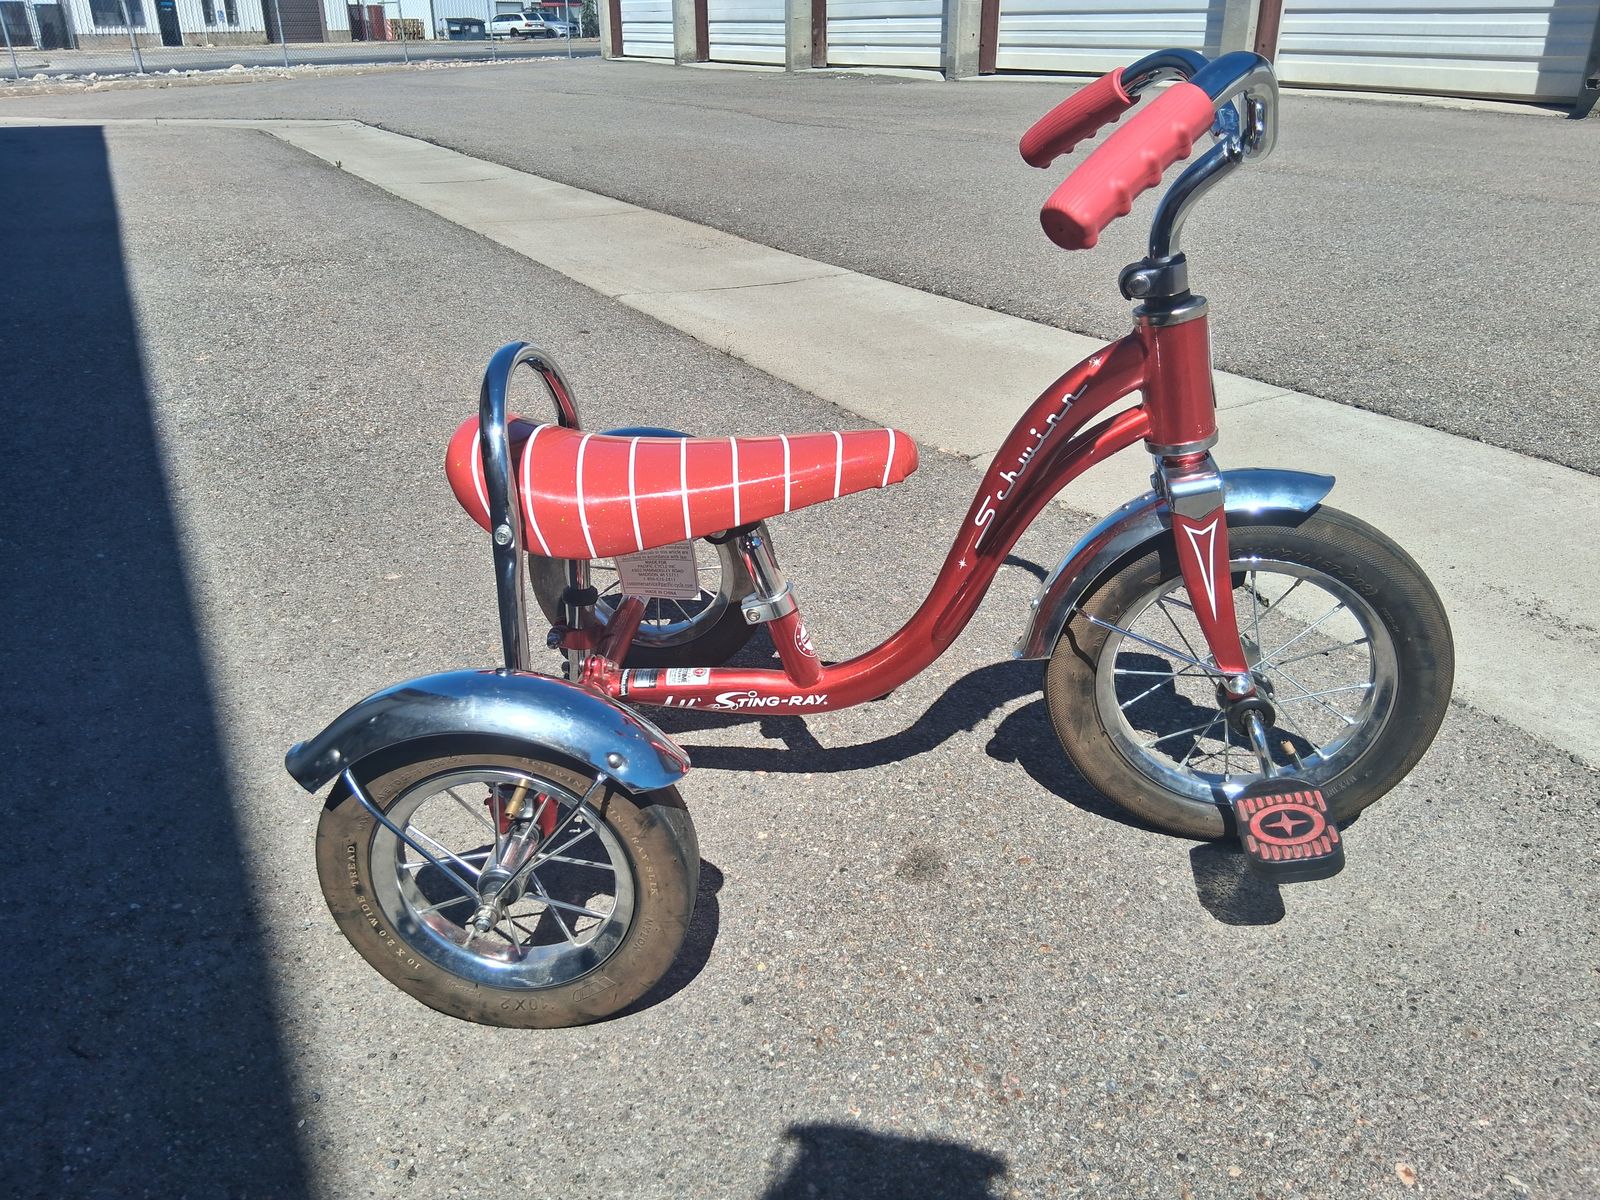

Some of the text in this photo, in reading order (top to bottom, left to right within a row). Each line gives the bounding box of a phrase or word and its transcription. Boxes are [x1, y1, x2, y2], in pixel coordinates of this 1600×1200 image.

[974, 384, 1088, 549] Schwinn
[346, 846, 360, 887] TREAD
[357, 895, 380, 928] WIDE
[378, 929, 396, 947] 2.0
[407, 957, 422, 971] 10
